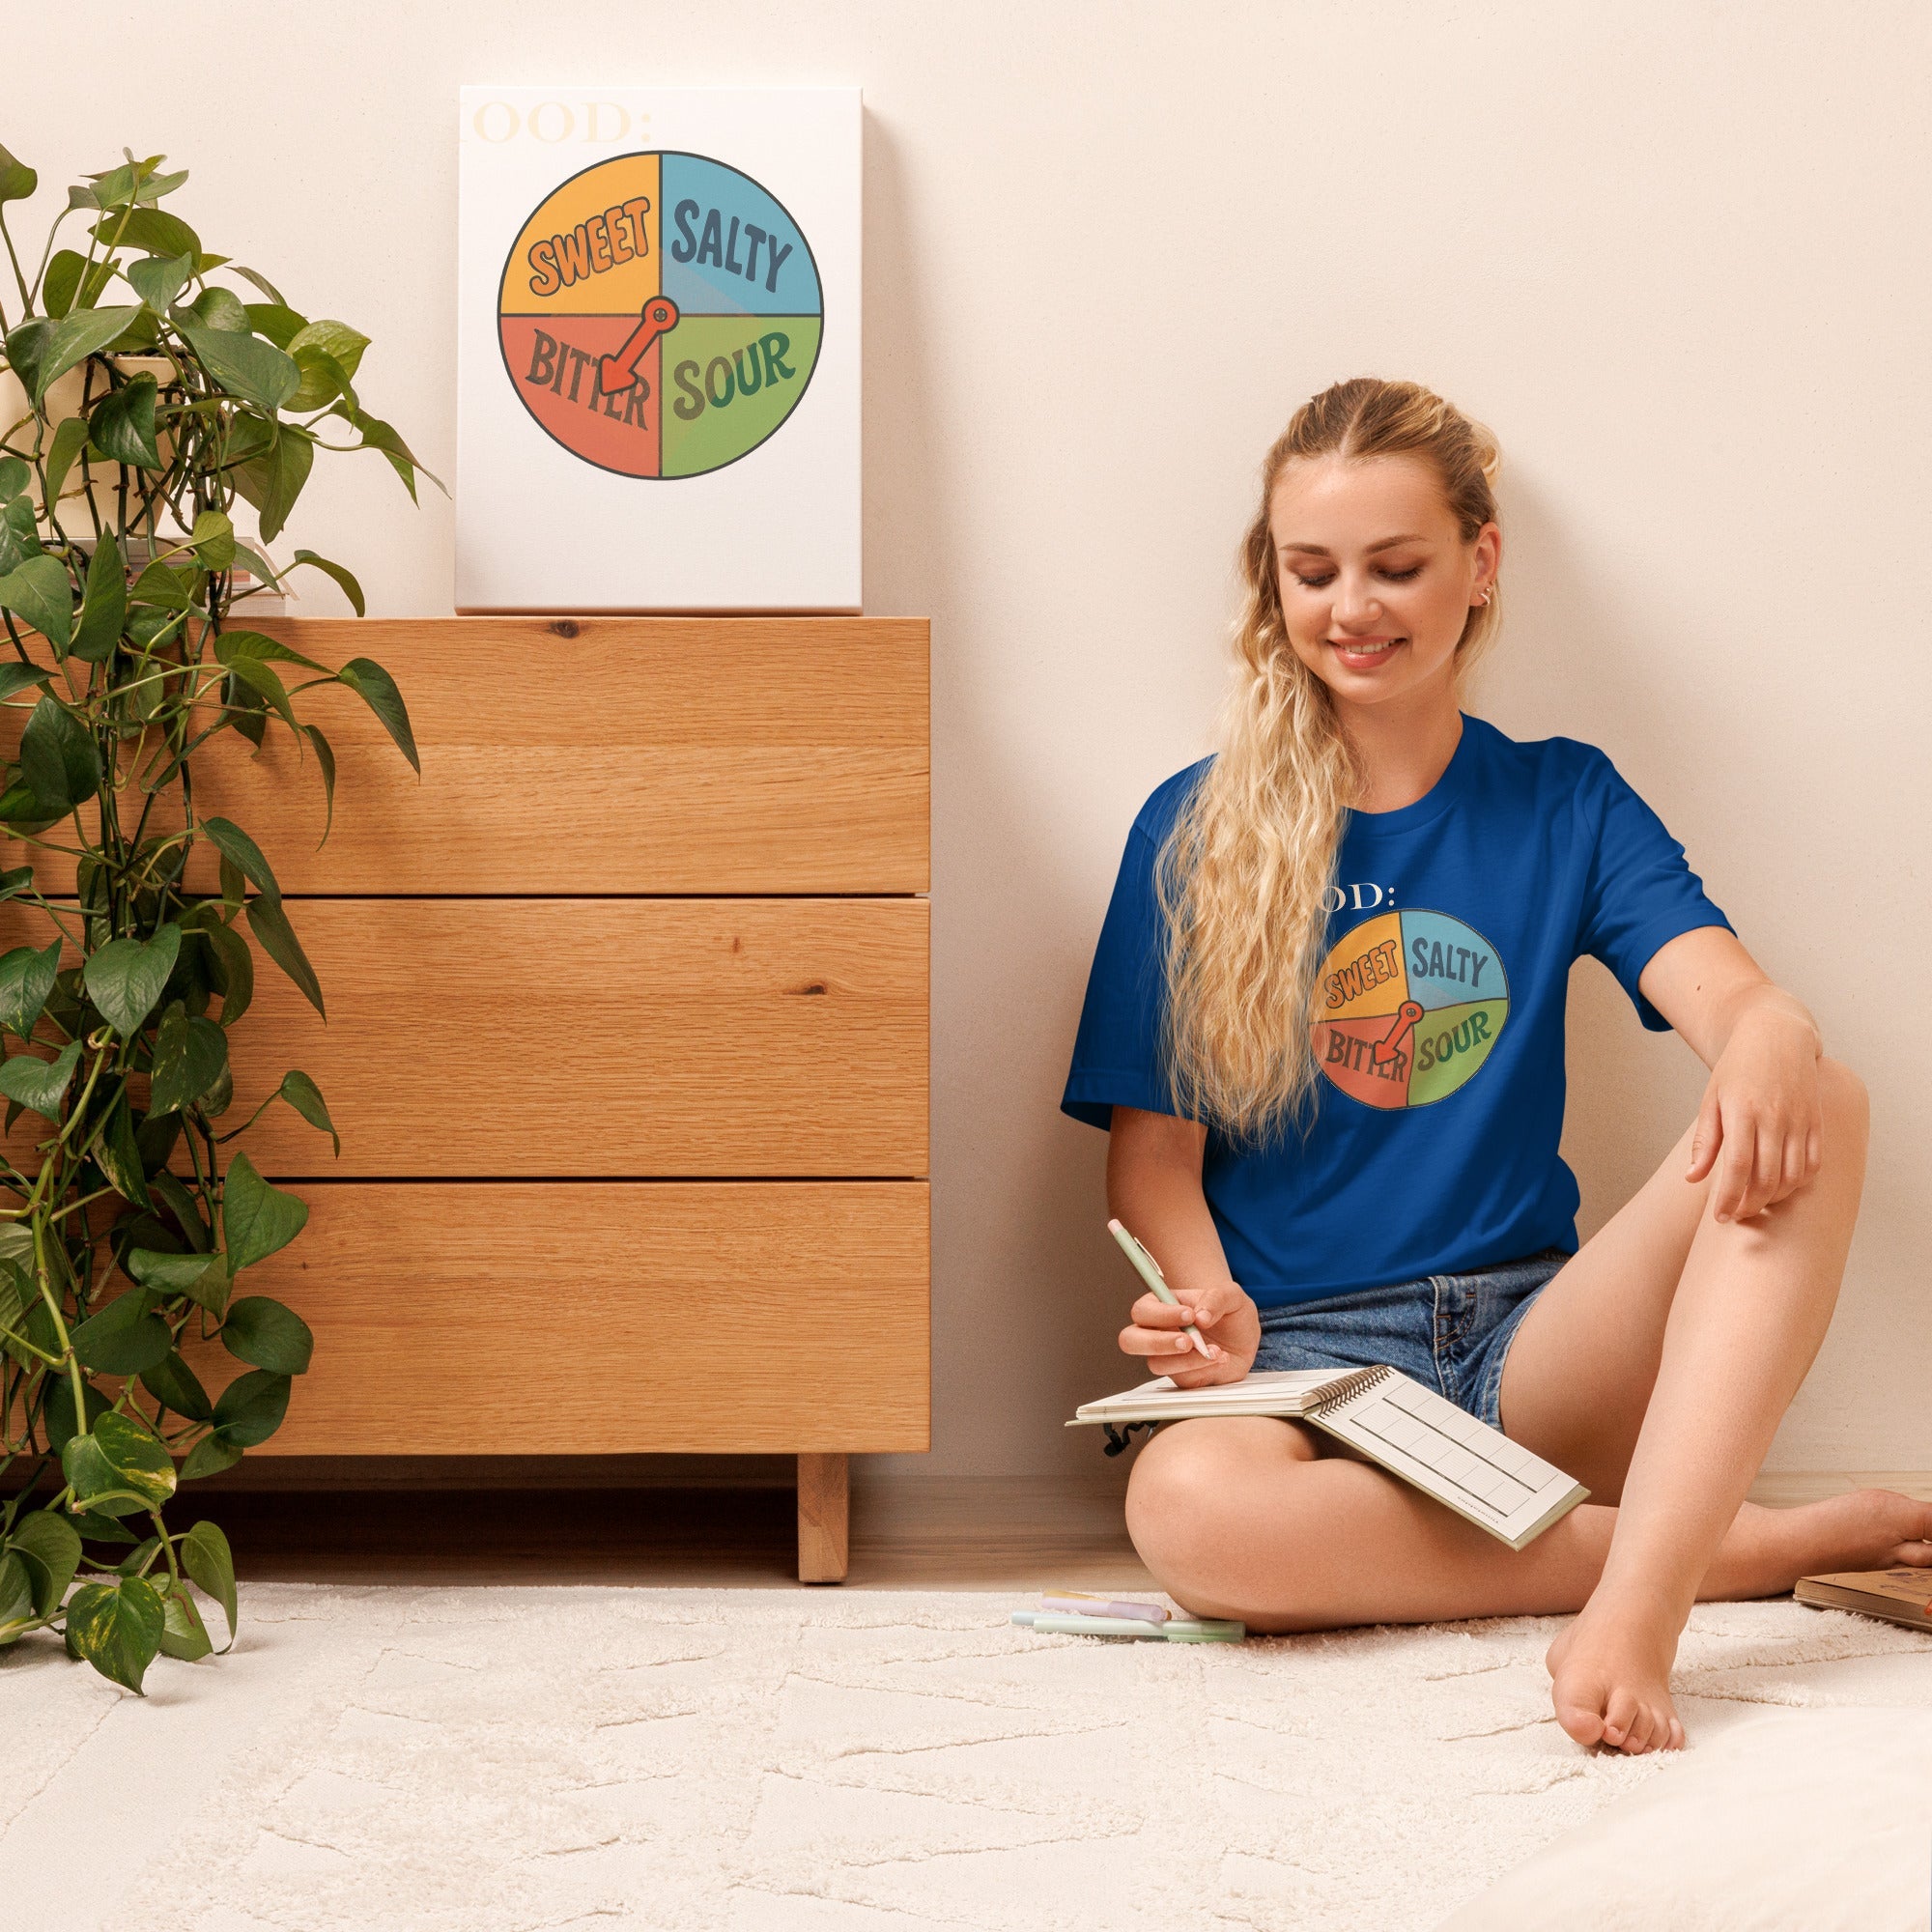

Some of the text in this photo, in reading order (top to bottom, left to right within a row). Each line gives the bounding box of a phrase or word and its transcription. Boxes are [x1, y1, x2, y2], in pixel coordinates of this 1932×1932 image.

[459, 100, 651, 144] OOD:
[527, 196, 651, 297] SWEET
[670, 198, 793, 294] SALTY
[672, 331, 796, 421] SOUR
[1323, 939, 1399, 1009] SWEET
[1411, 937, 1489, 987] SALTY
[1417, 1010, 1492, 1071] SOUR
